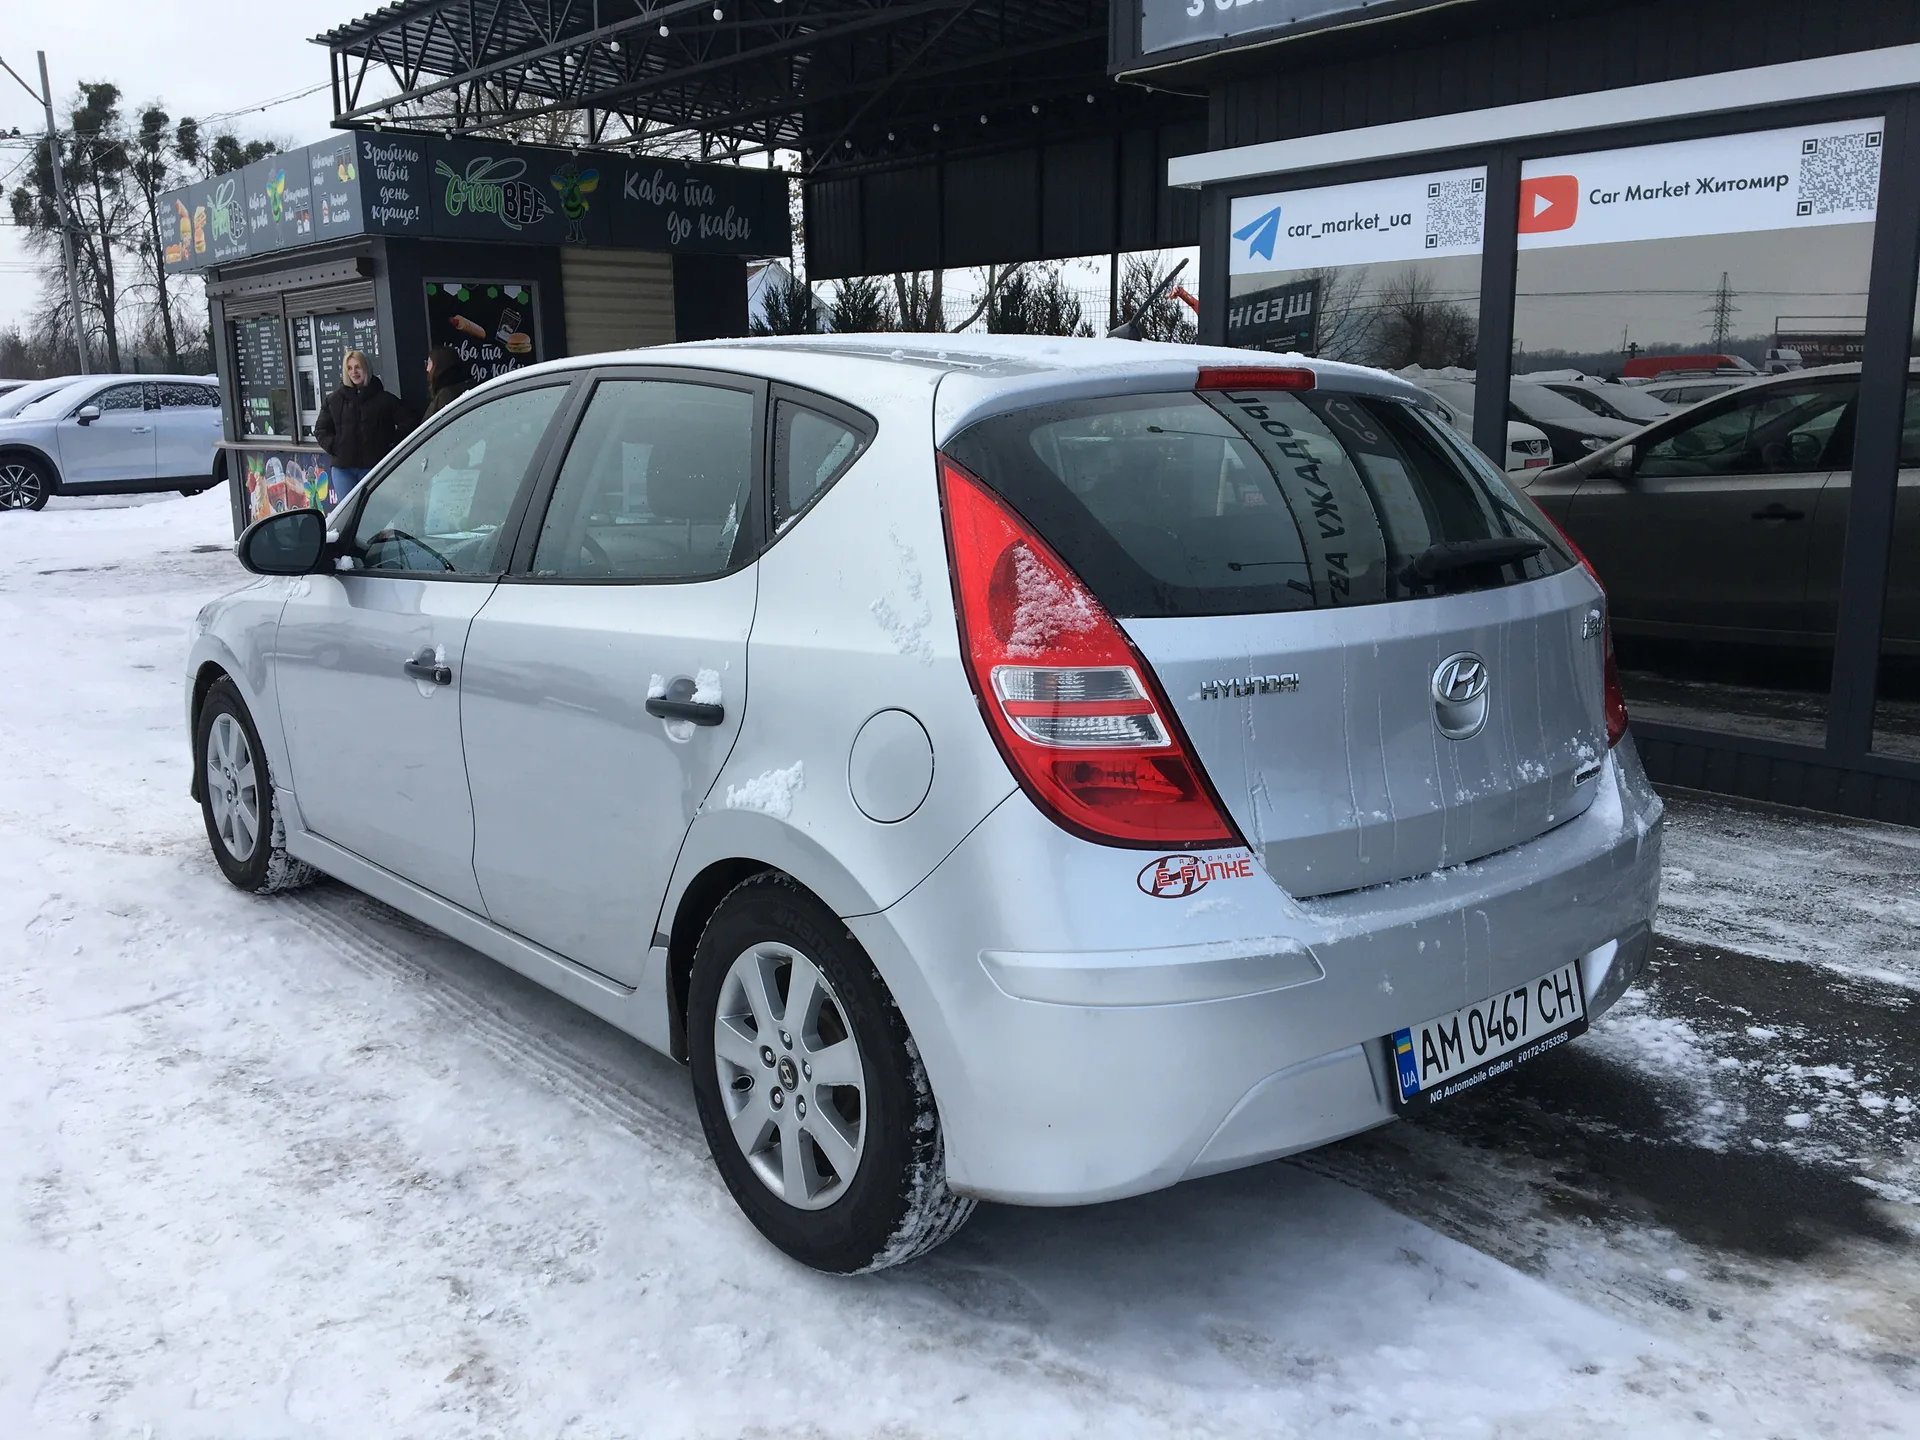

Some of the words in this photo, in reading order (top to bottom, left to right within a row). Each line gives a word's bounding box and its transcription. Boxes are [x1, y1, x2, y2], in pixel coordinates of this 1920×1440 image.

[363, 141, 419, 166] Зробимо
[376, 162, 409, 181] твій
[380, 186, 410, 204] день
[624, 168, 679, 205] Кава
[684, 178, 716, 207] та
[1589, 188, 1620, 205] Car
[1625, 180, 1691, 202] Market
[1695, 173, 1790, 195] Житомир
[370, 205, 420, 226] краще!
[667, 210, 692, 245] до
[698, 205, 751, 240] кави
[1287, 212, 1412, 239] car_market_ua
[481, 343, 504, 361] та
[470, 363, 487, 382] до
[1200, 672, 1300, 701] HYUNDAI
[1421, 1016, 1466, 1081] AM
[1468, 986, 1529, 1056] 0467
[1537, 968, 1576, 1024] CH
[1402, 1069, 1418, 1089] UA
[1430, 1088, 1443, 1104] NG
[1444, 1070, 1487, 1098] Automobile
[1488, 1058, 1514, 1078] Gießen
